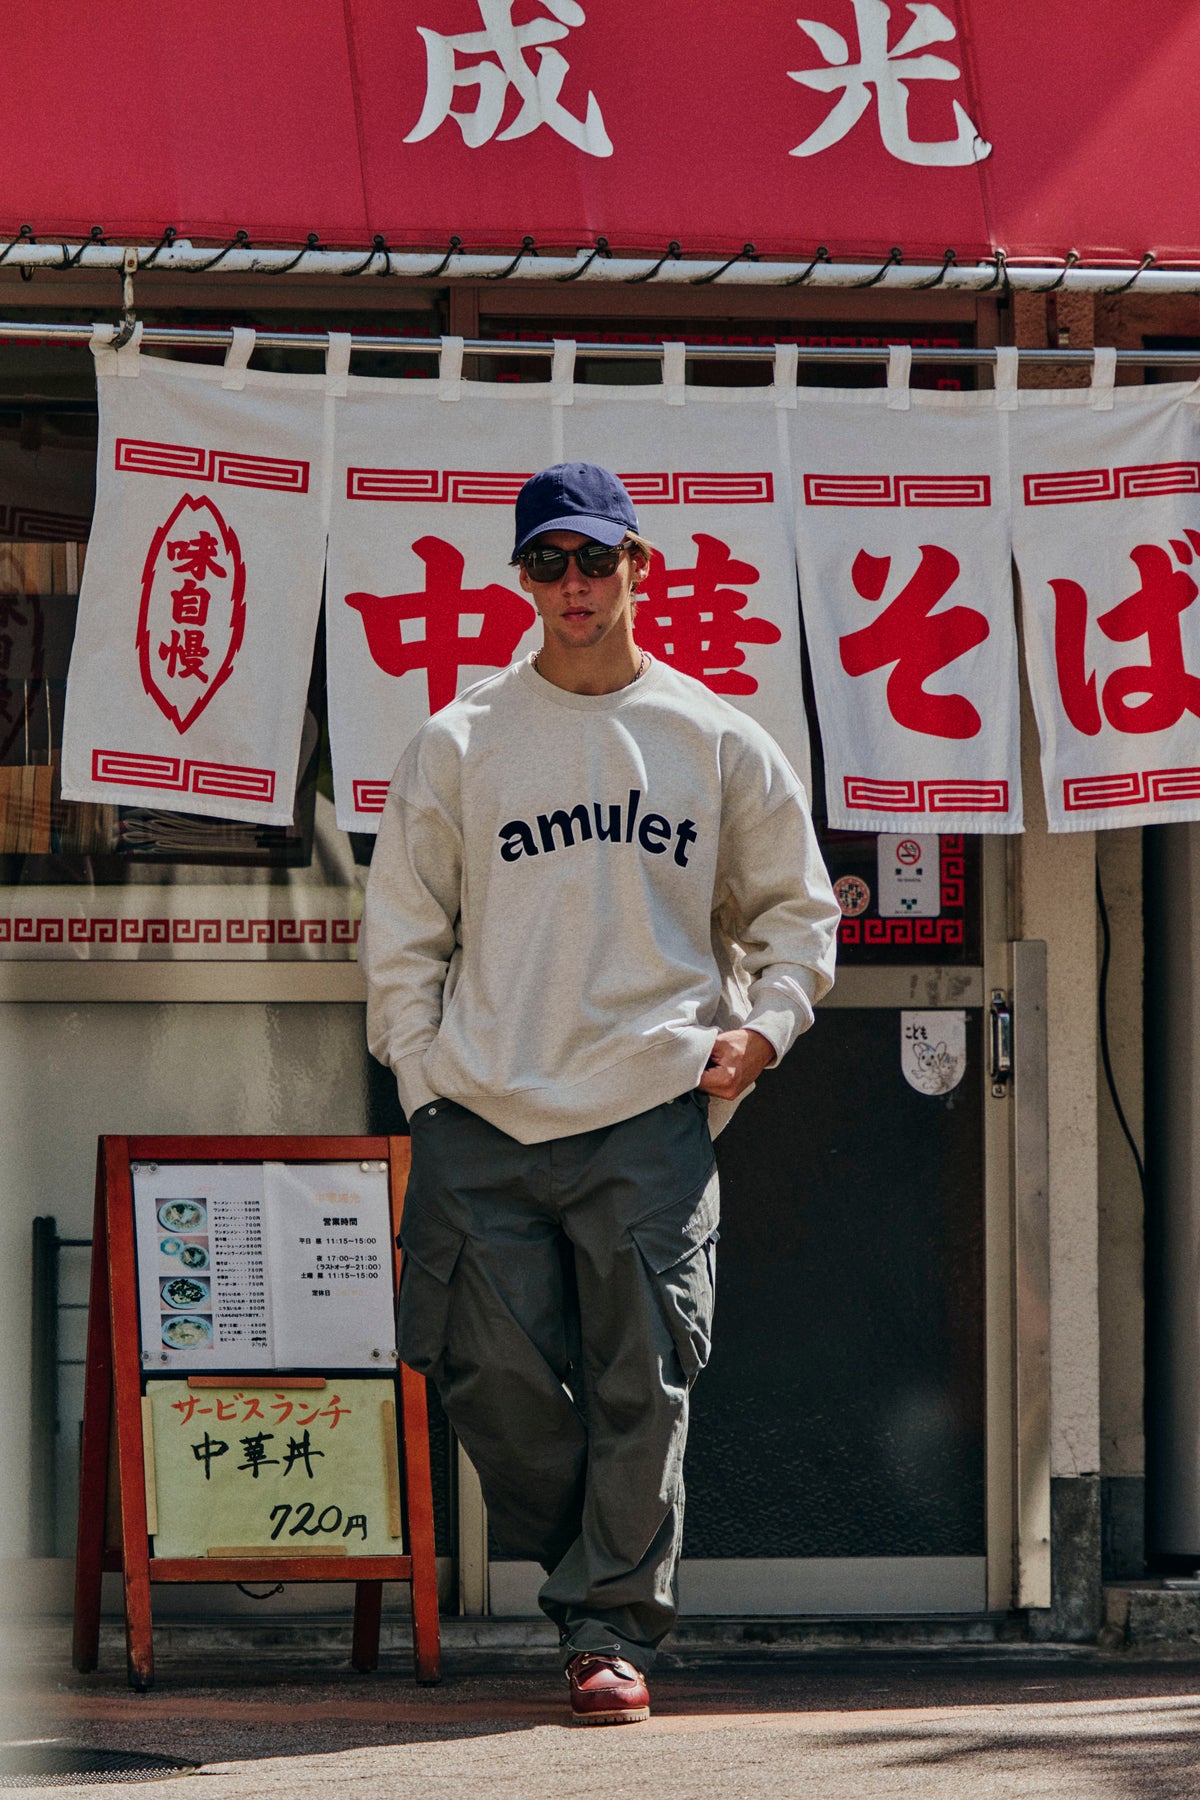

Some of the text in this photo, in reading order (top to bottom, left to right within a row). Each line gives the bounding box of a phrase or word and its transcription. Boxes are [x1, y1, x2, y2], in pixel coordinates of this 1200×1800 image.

[158, 531, 228, 684] 味自慢
[497, 788, 699, 869] amulet
[905, 1023, 928, 1040] こども
[322, 1217, 358, 1227] 営業時間
[312, 1289, 331, 1297] 定休日
[170, 1393, 352, 1430] サービスランチ
[269, 1502, 368, 1542] 720円
